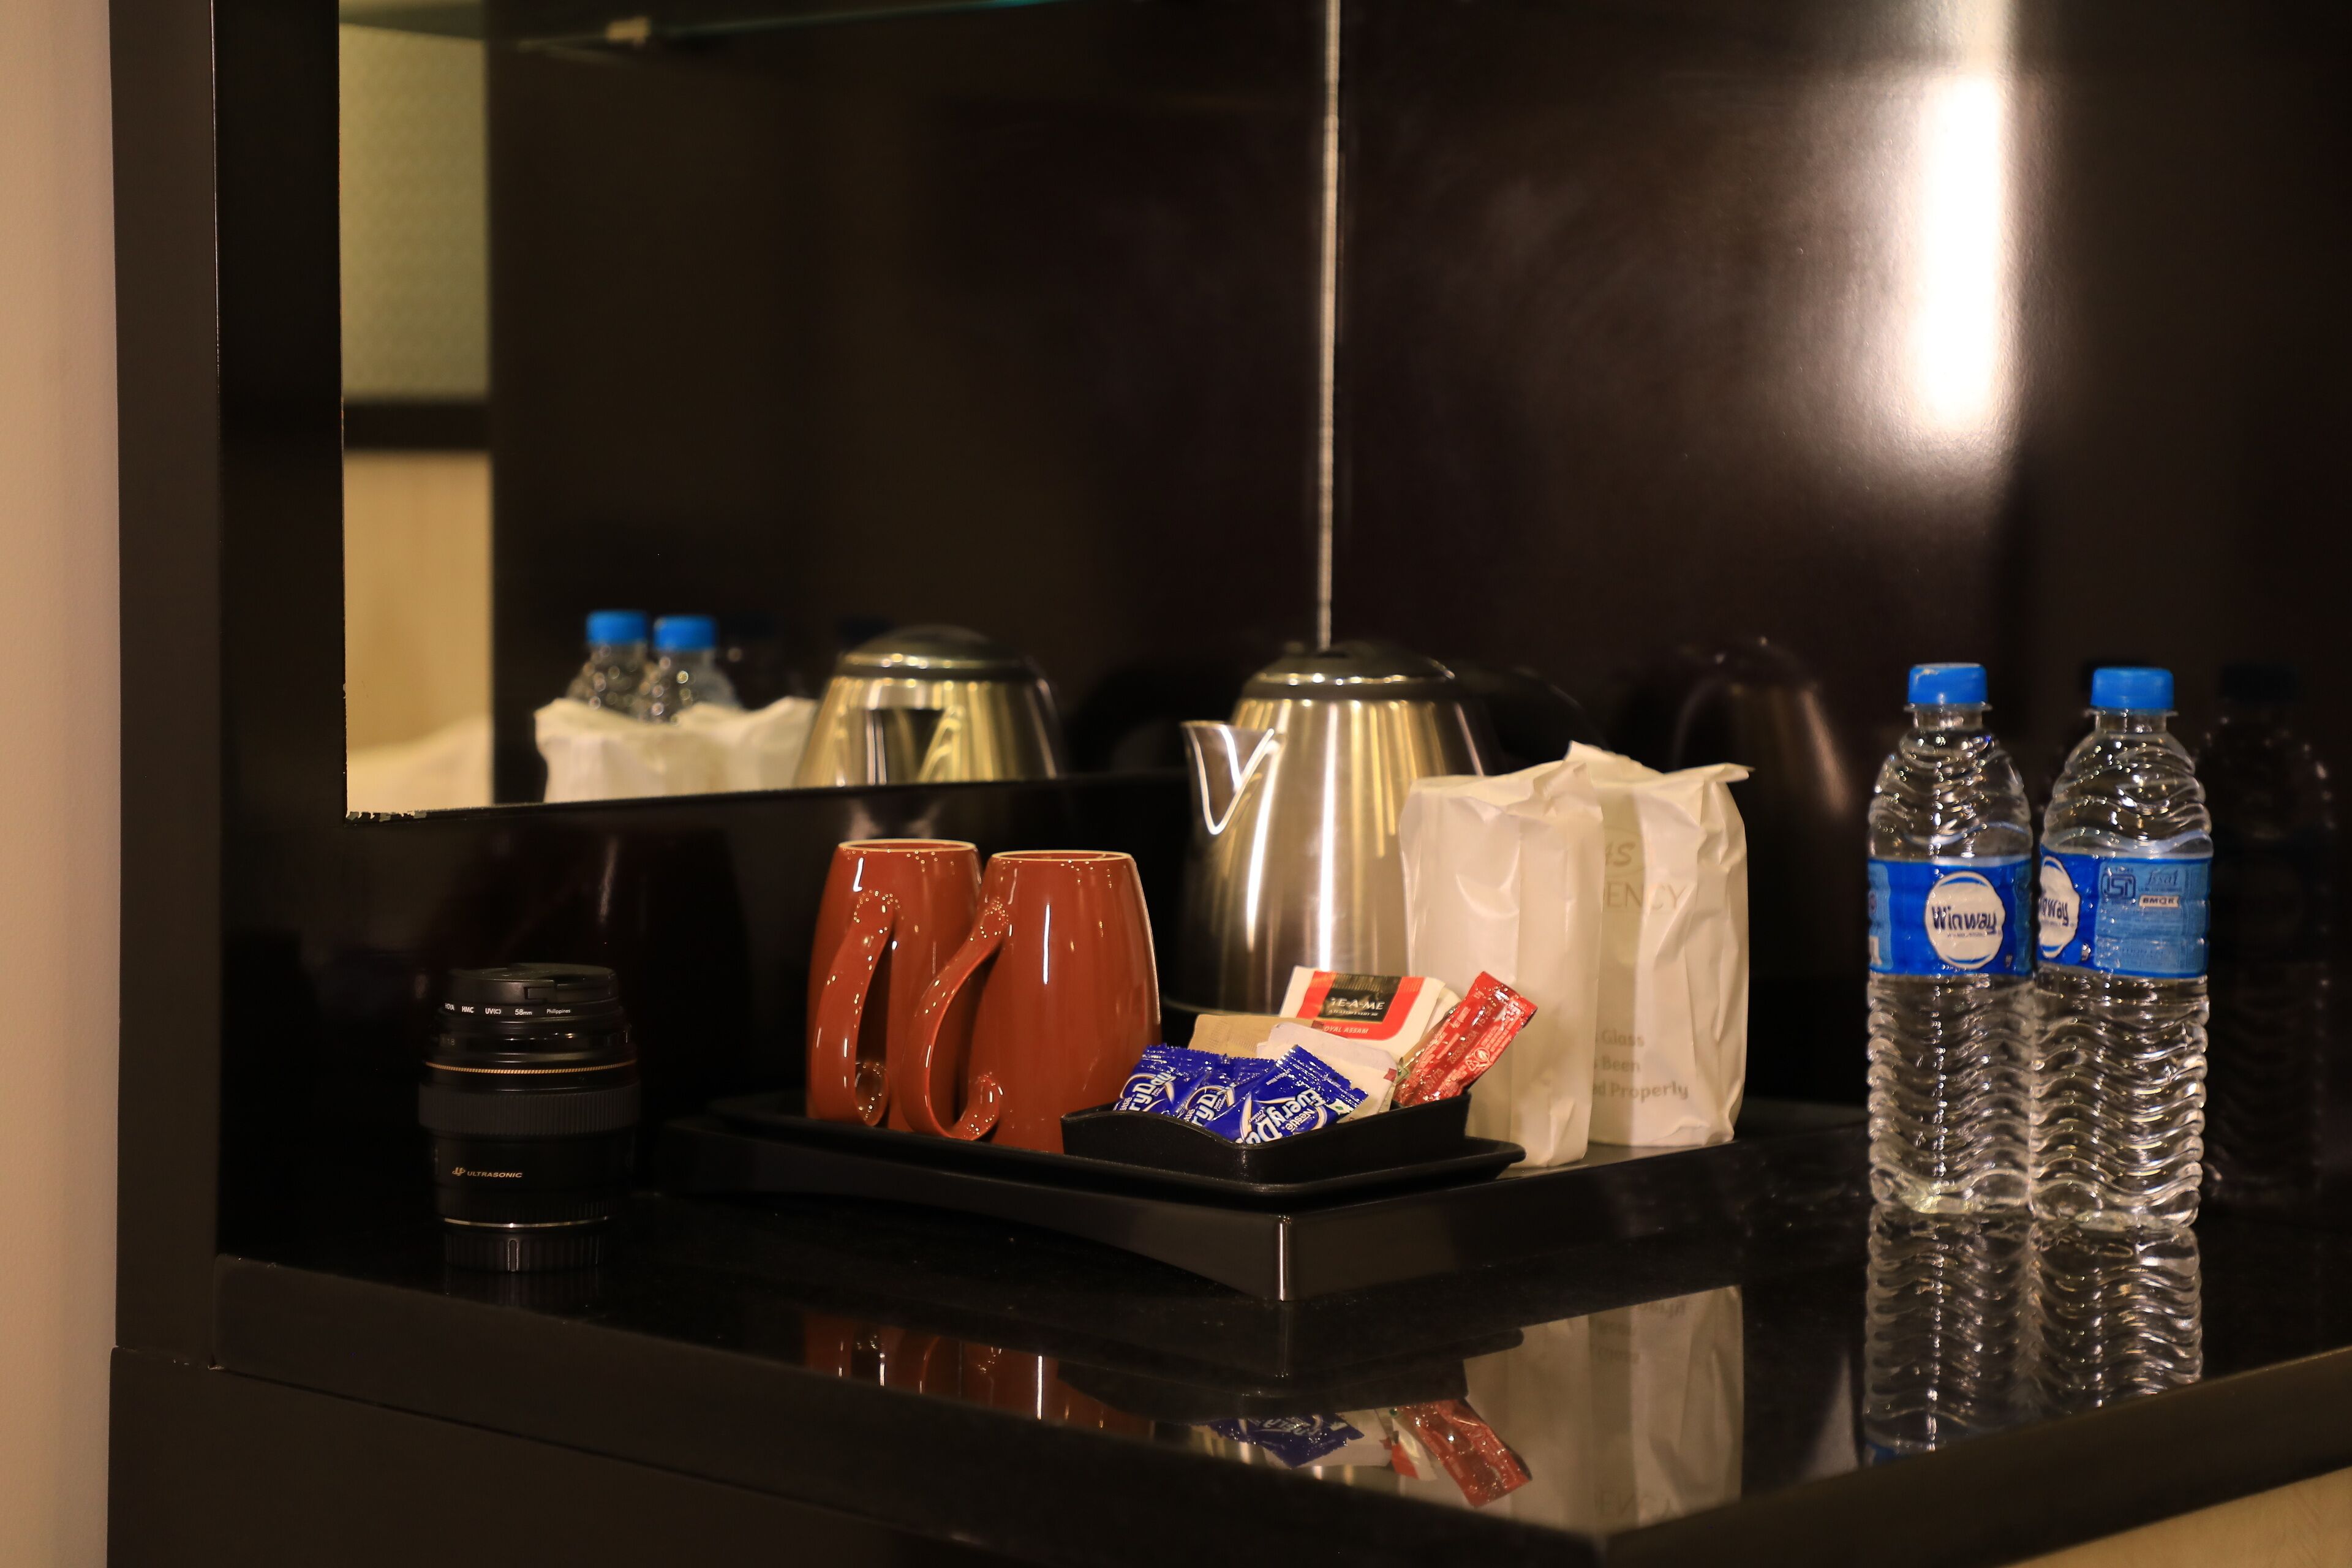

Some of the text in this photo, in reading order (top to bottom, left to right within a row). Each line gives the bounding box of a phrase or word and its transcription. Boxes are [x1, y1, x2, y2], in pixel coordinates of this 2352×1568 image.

[1931, 905, 1997, 935] Winway
[445, 1002, 455, 1011] HOYA
[1602, 1028, 1645, 1047] Glass
[1602, 1055, 1641, 1072] Been
[1610, 1079, 1689, 1103] Properly
